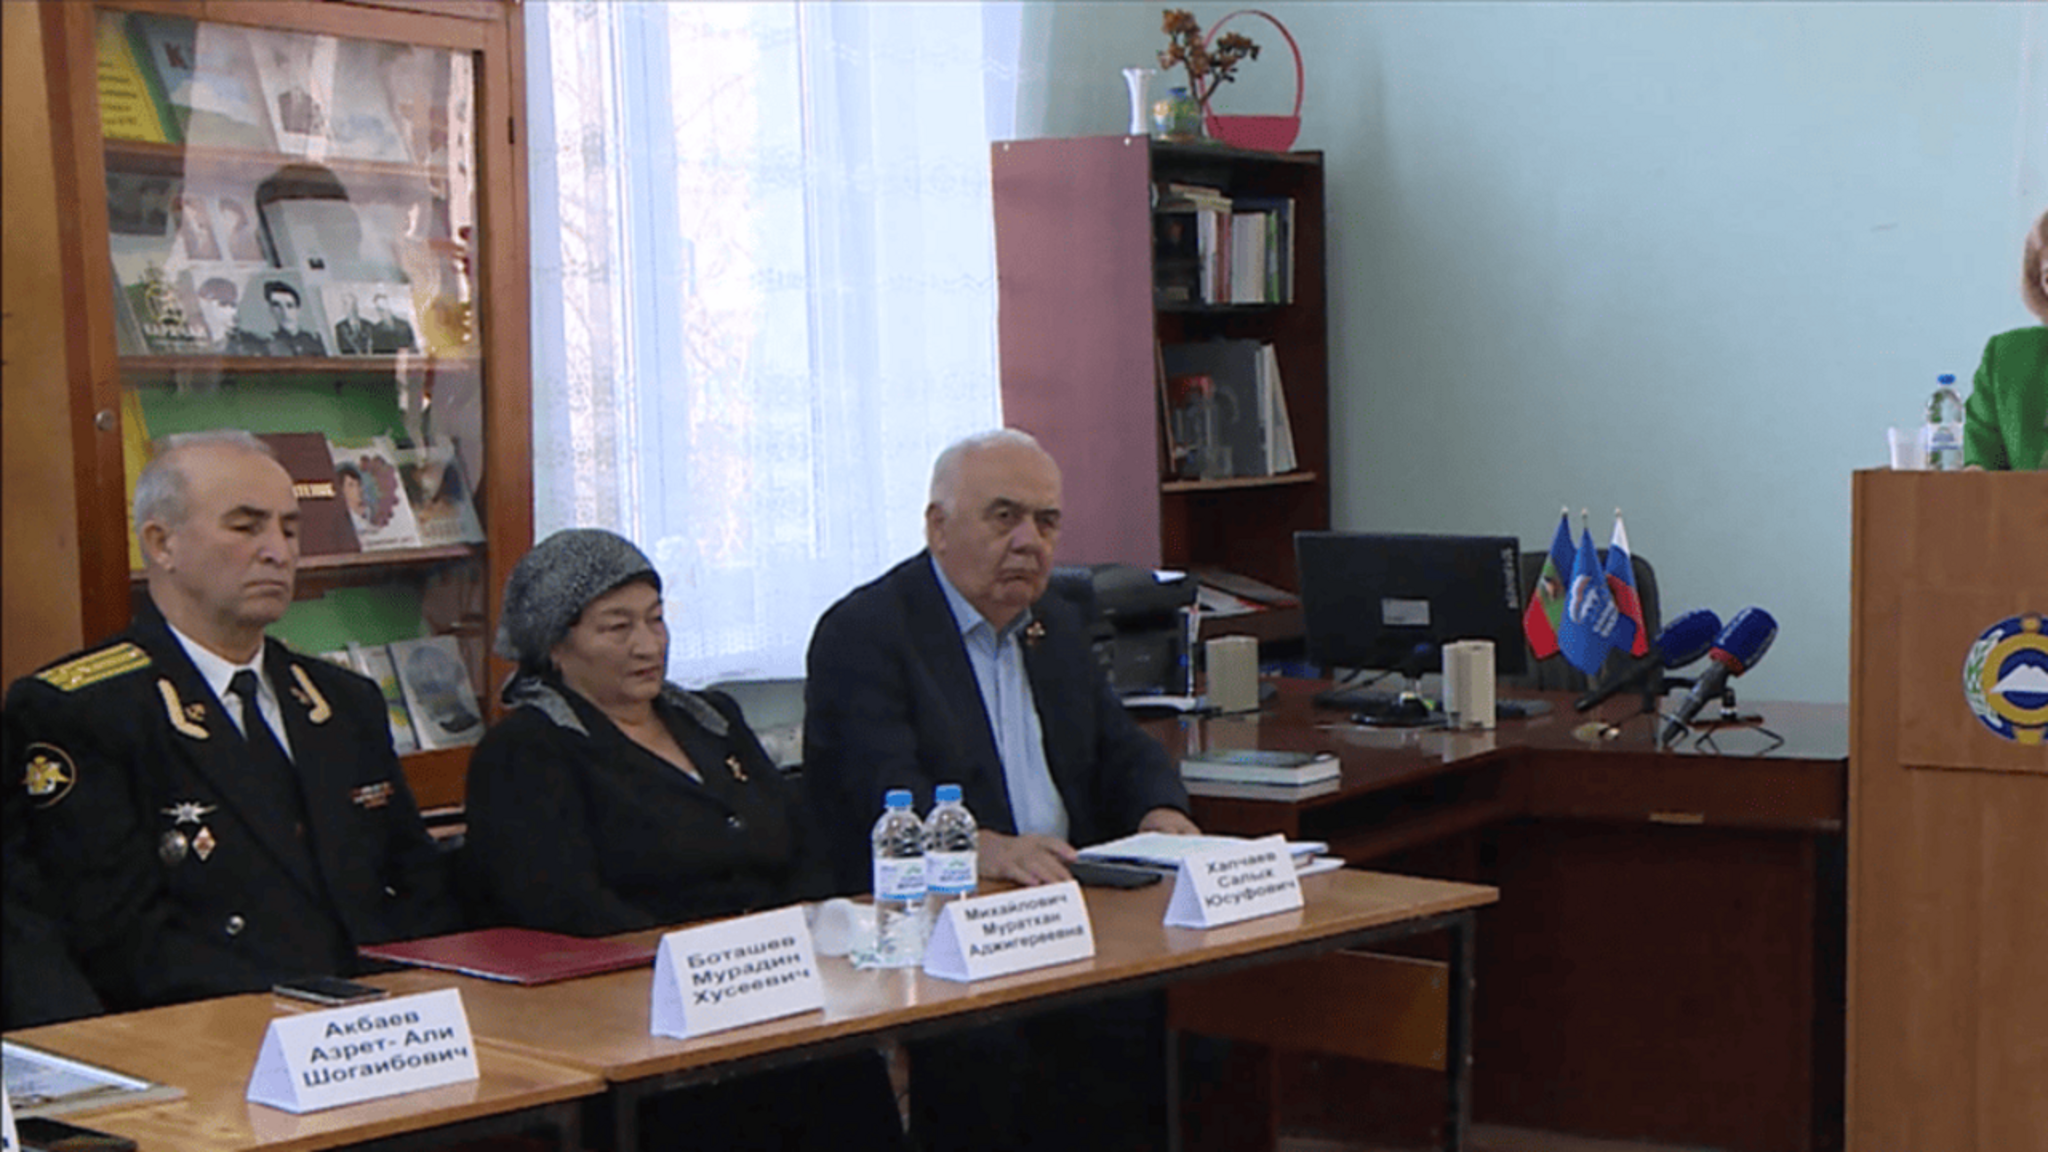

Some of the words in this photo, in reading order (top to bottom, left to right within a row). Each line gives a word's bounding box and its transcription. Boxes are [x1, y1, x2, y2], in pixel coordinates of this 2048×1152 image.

[1205, 851, 1277, 874] Хапчаев
[964, 894, 1068, 921] Михайлович
[1204, 880, 1296, 908] Юсуфович
[982, 912, 1062, 937] Муратхан
[686, 935, 797, 969] Боташев
[691, 953, 801, 987] Мурадин
[692, 968, 811, 1006] Хусеевич
[325, 1010, 420, 1039] Акбаев
[404, 1026, 455, 1047] Али
[302, 1046, 469, 1088] Шогаибович
